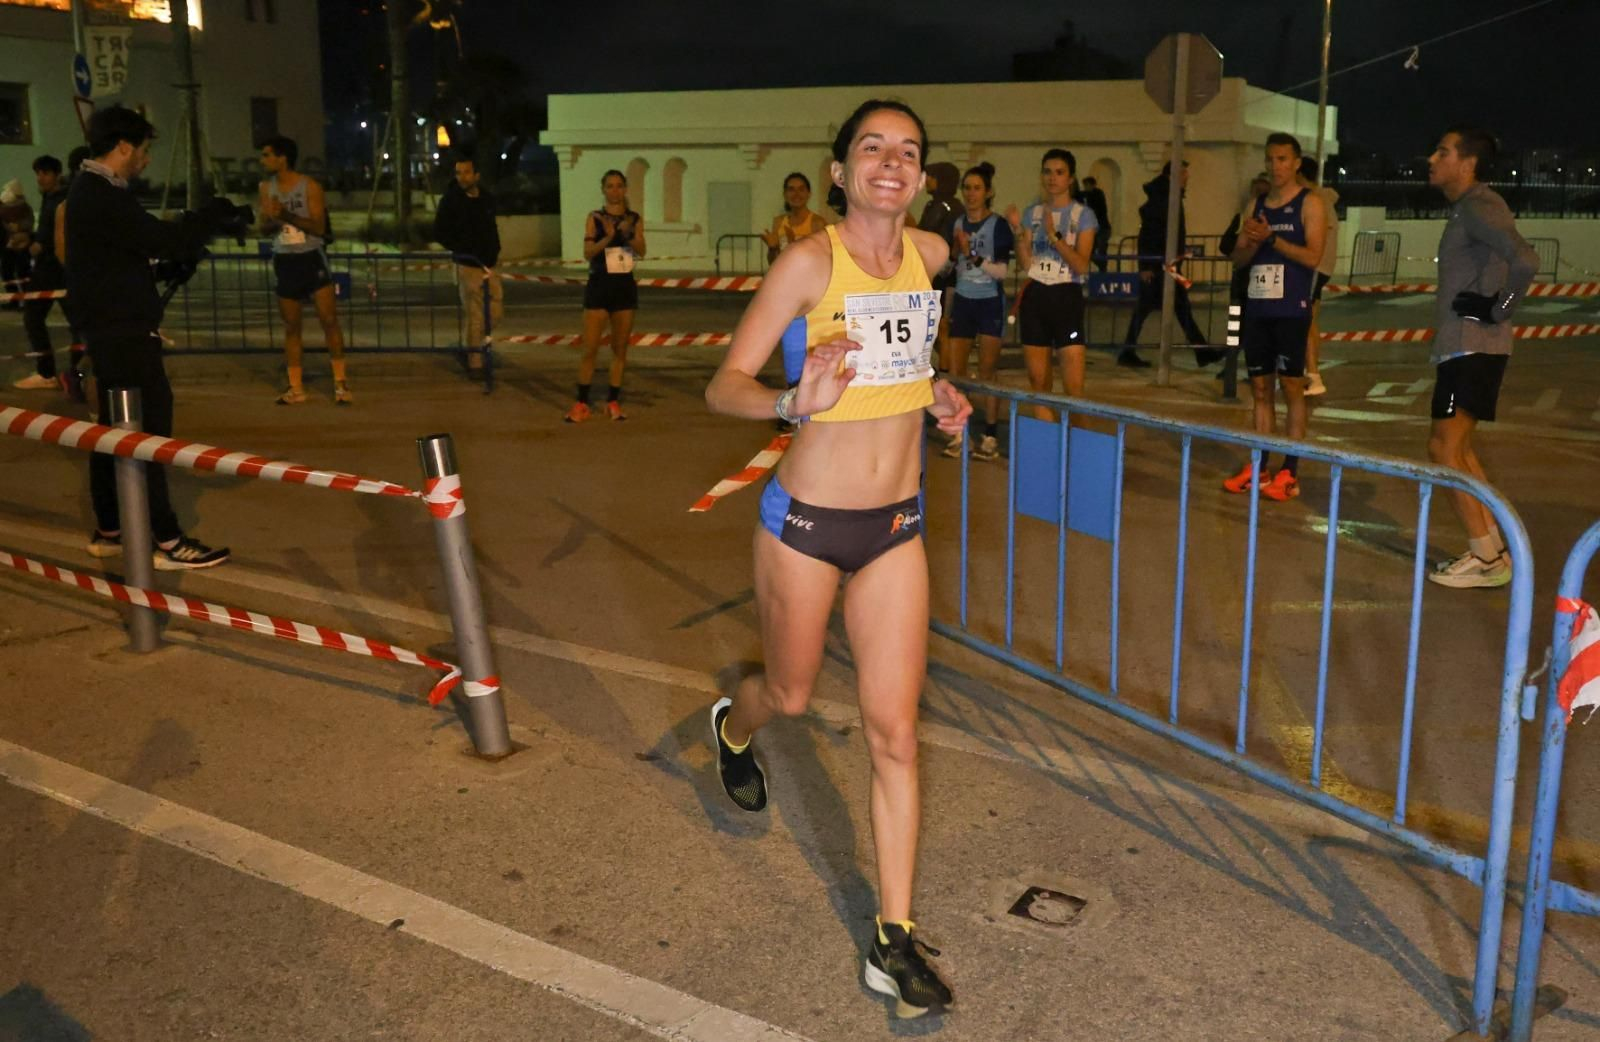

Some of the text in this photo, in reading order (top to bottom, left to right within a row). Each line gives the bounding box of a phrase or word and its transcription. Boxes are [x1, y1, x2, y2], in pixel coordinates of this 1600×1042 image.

[1039, 262, 1051, 272] 11
[1255, 274, 1266, 284] 14
[909, 294, 922, 309] M
[880, 319, 911, 344] 15
